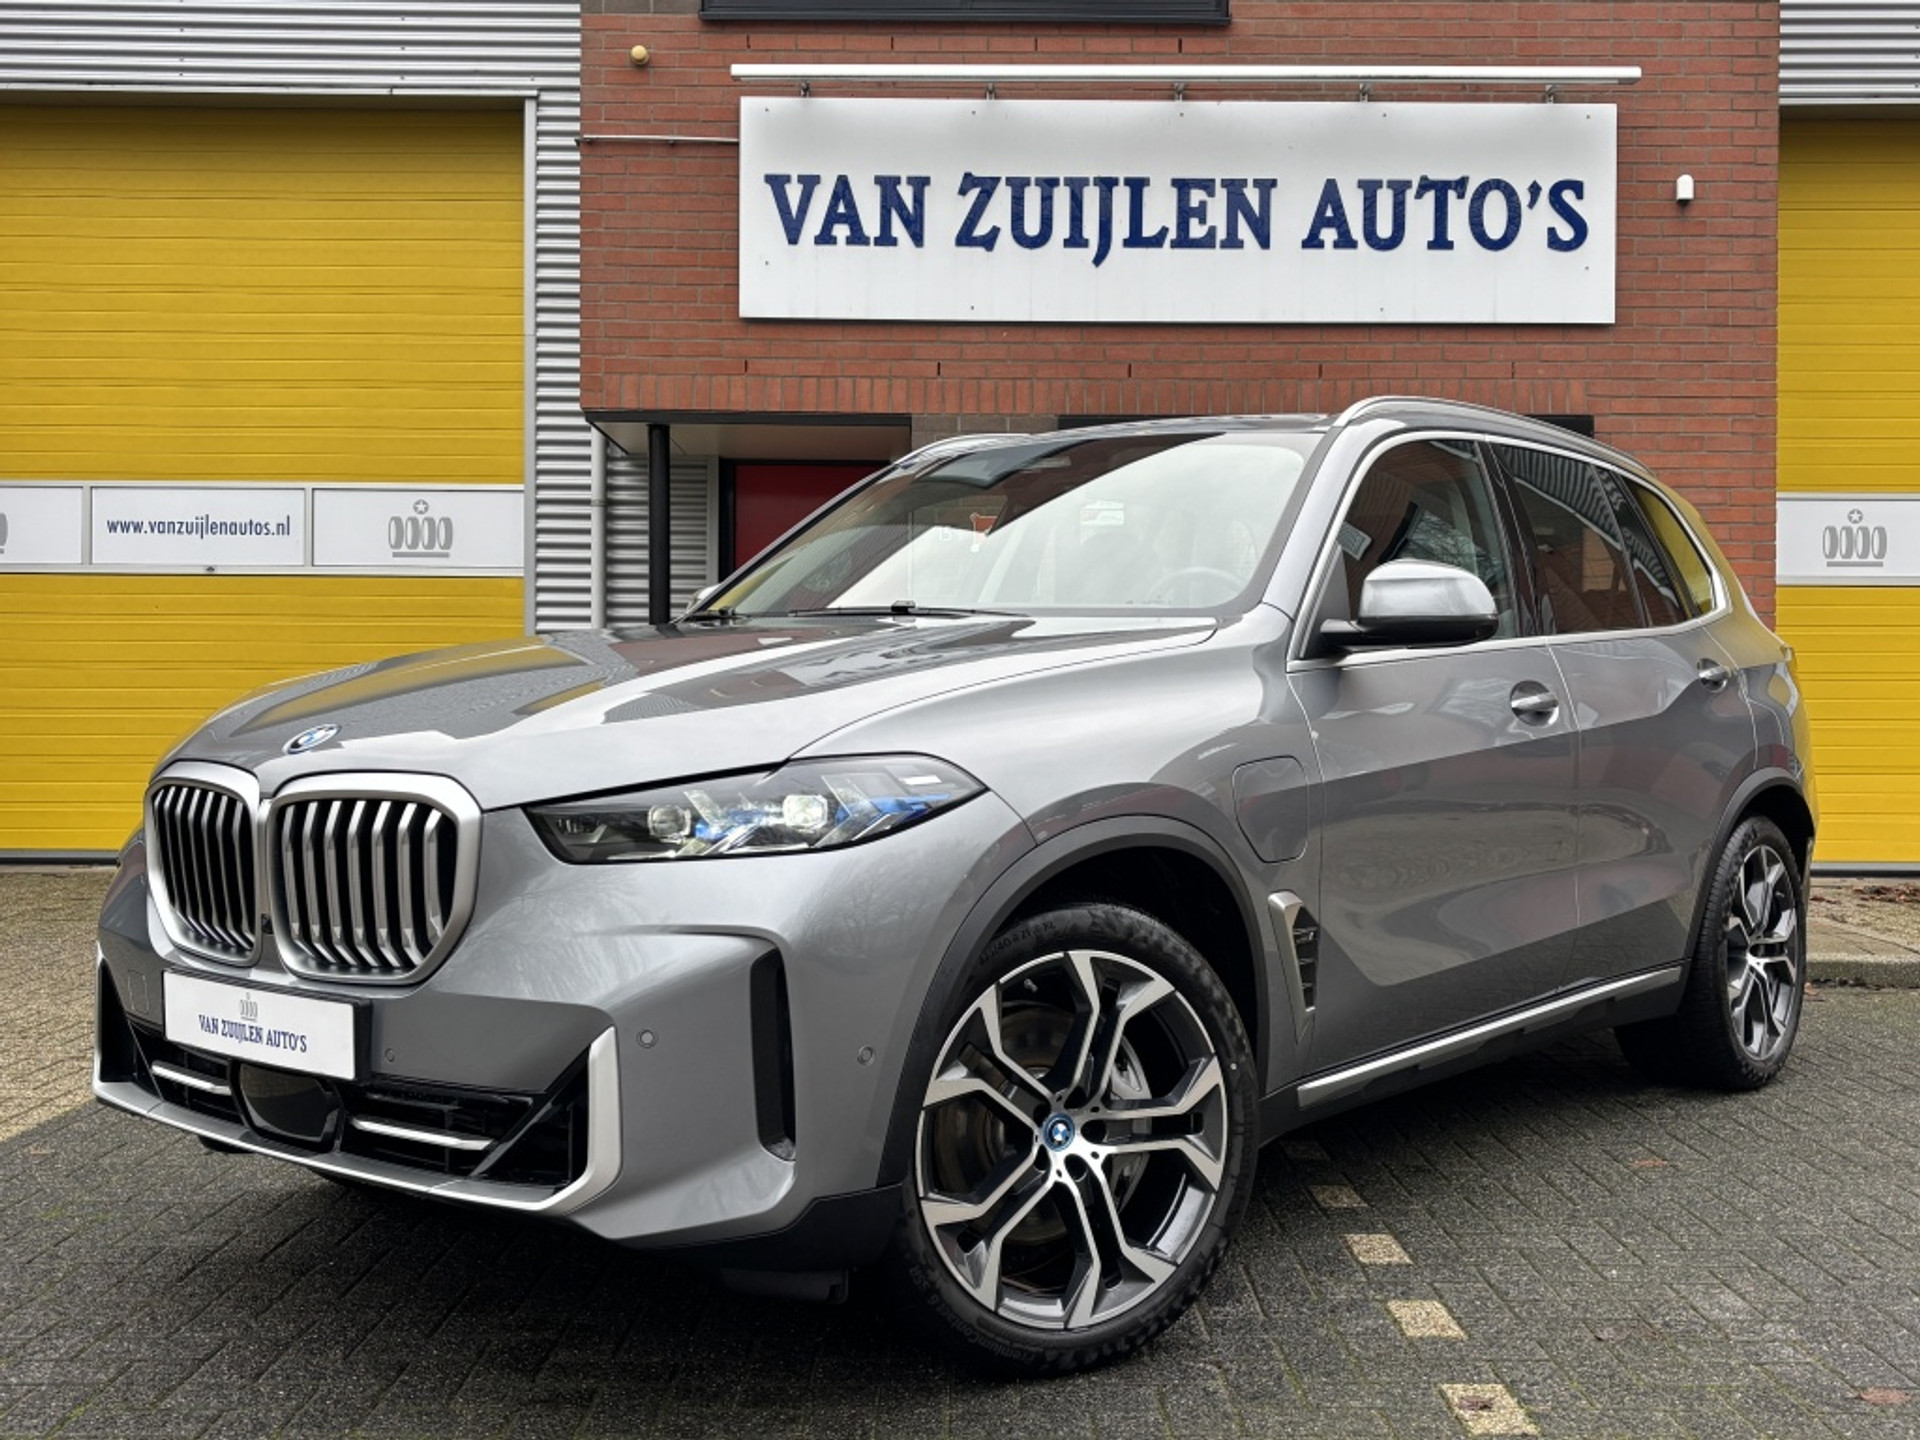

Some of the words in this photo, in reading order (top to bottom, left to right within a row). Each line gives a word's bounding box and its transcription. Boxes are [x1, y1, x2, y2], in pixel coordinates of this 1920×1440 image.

[764, 174, 931, 248] VAN
[954, 172, 1278, 268] ZUIJLEN
[1301, 175, 1588, 253] AUTO'S
[106, 513, 291, 539] www.vanzuijlenautos.nl
[199, 1015, 219, 1035] VAN
[266, 1029, 307, 1052] AUTO'S
